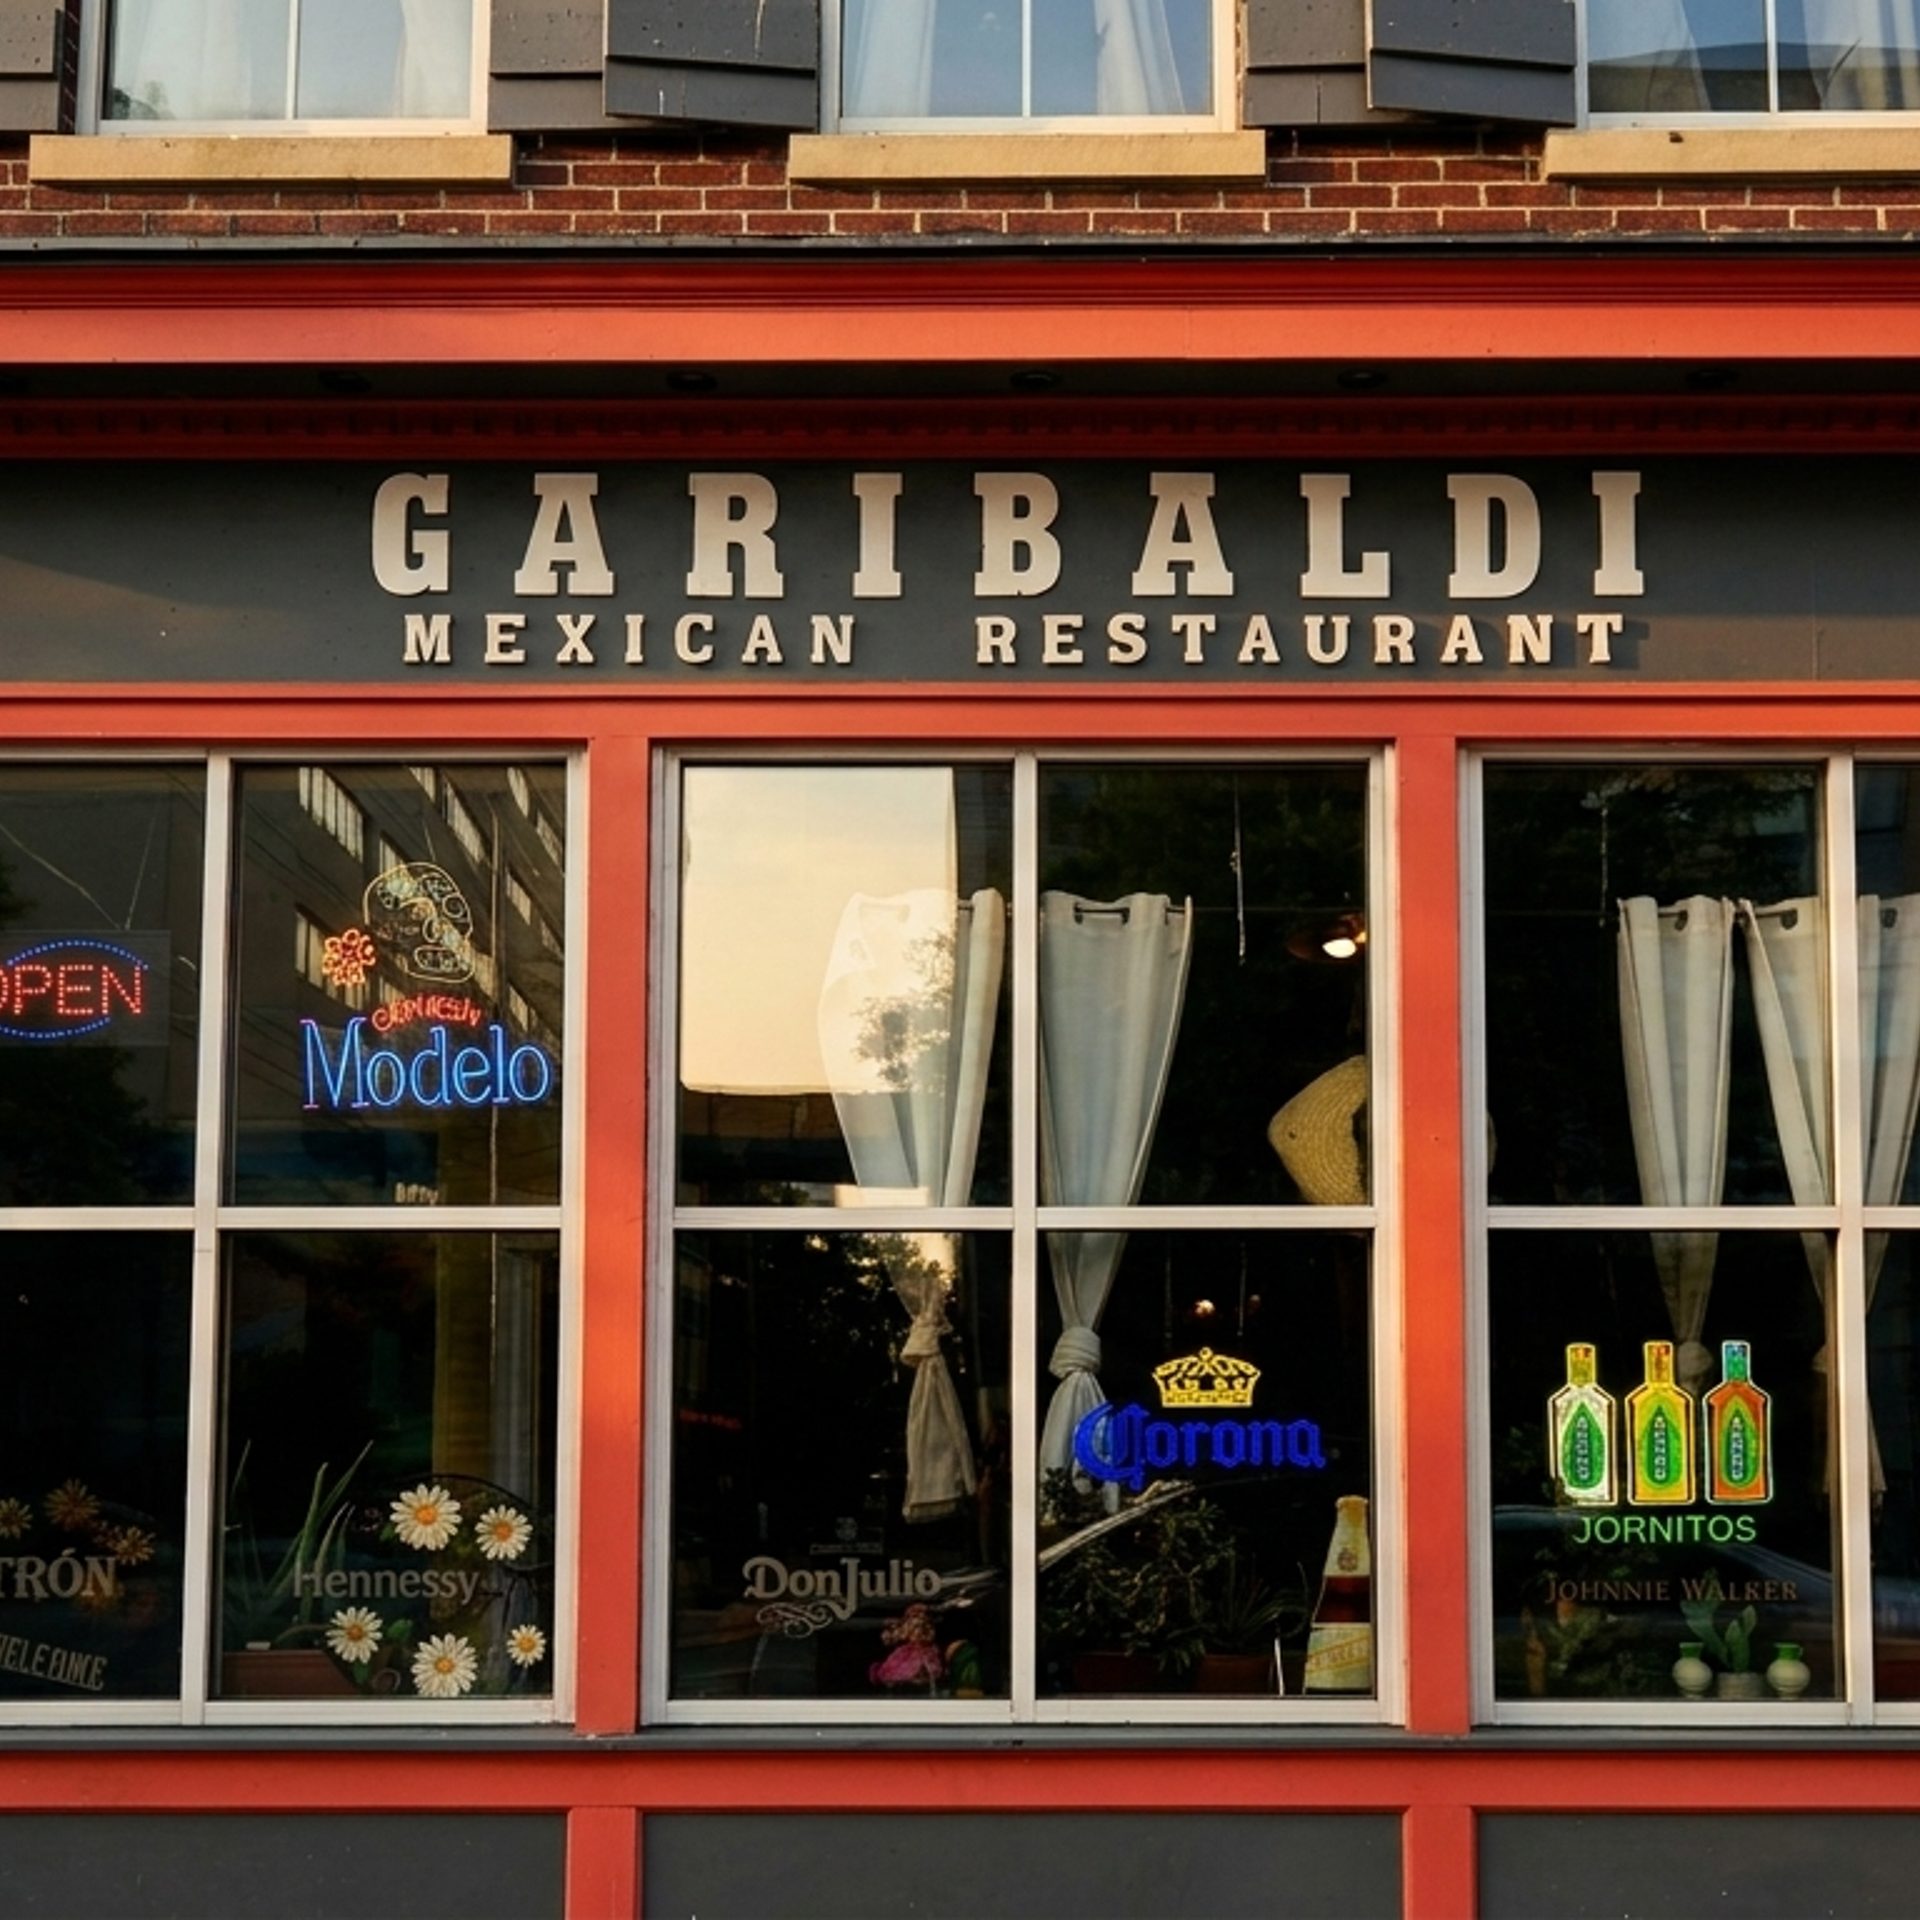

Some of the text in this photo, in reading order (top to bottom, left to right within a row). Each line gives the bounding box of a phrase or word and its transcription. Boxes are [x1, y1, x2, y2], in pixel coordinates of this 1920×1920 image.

[371, 471, 1645, 598] GARIBALDI
[402, 613, 1626, 665] MEXICAN RESTAURANT
[0, 963, 144, 1016] PEN
[300, 1015, 550, 1109] Modelo
[1073, 1402, 1328, 1490] Corona
[1572, 1513, 1758, 1544] JORNITOS
[294, 1565, 480, 1605] Hennessy
[1545, 1576, 1800, 1604] JOHNNIE WALKER
